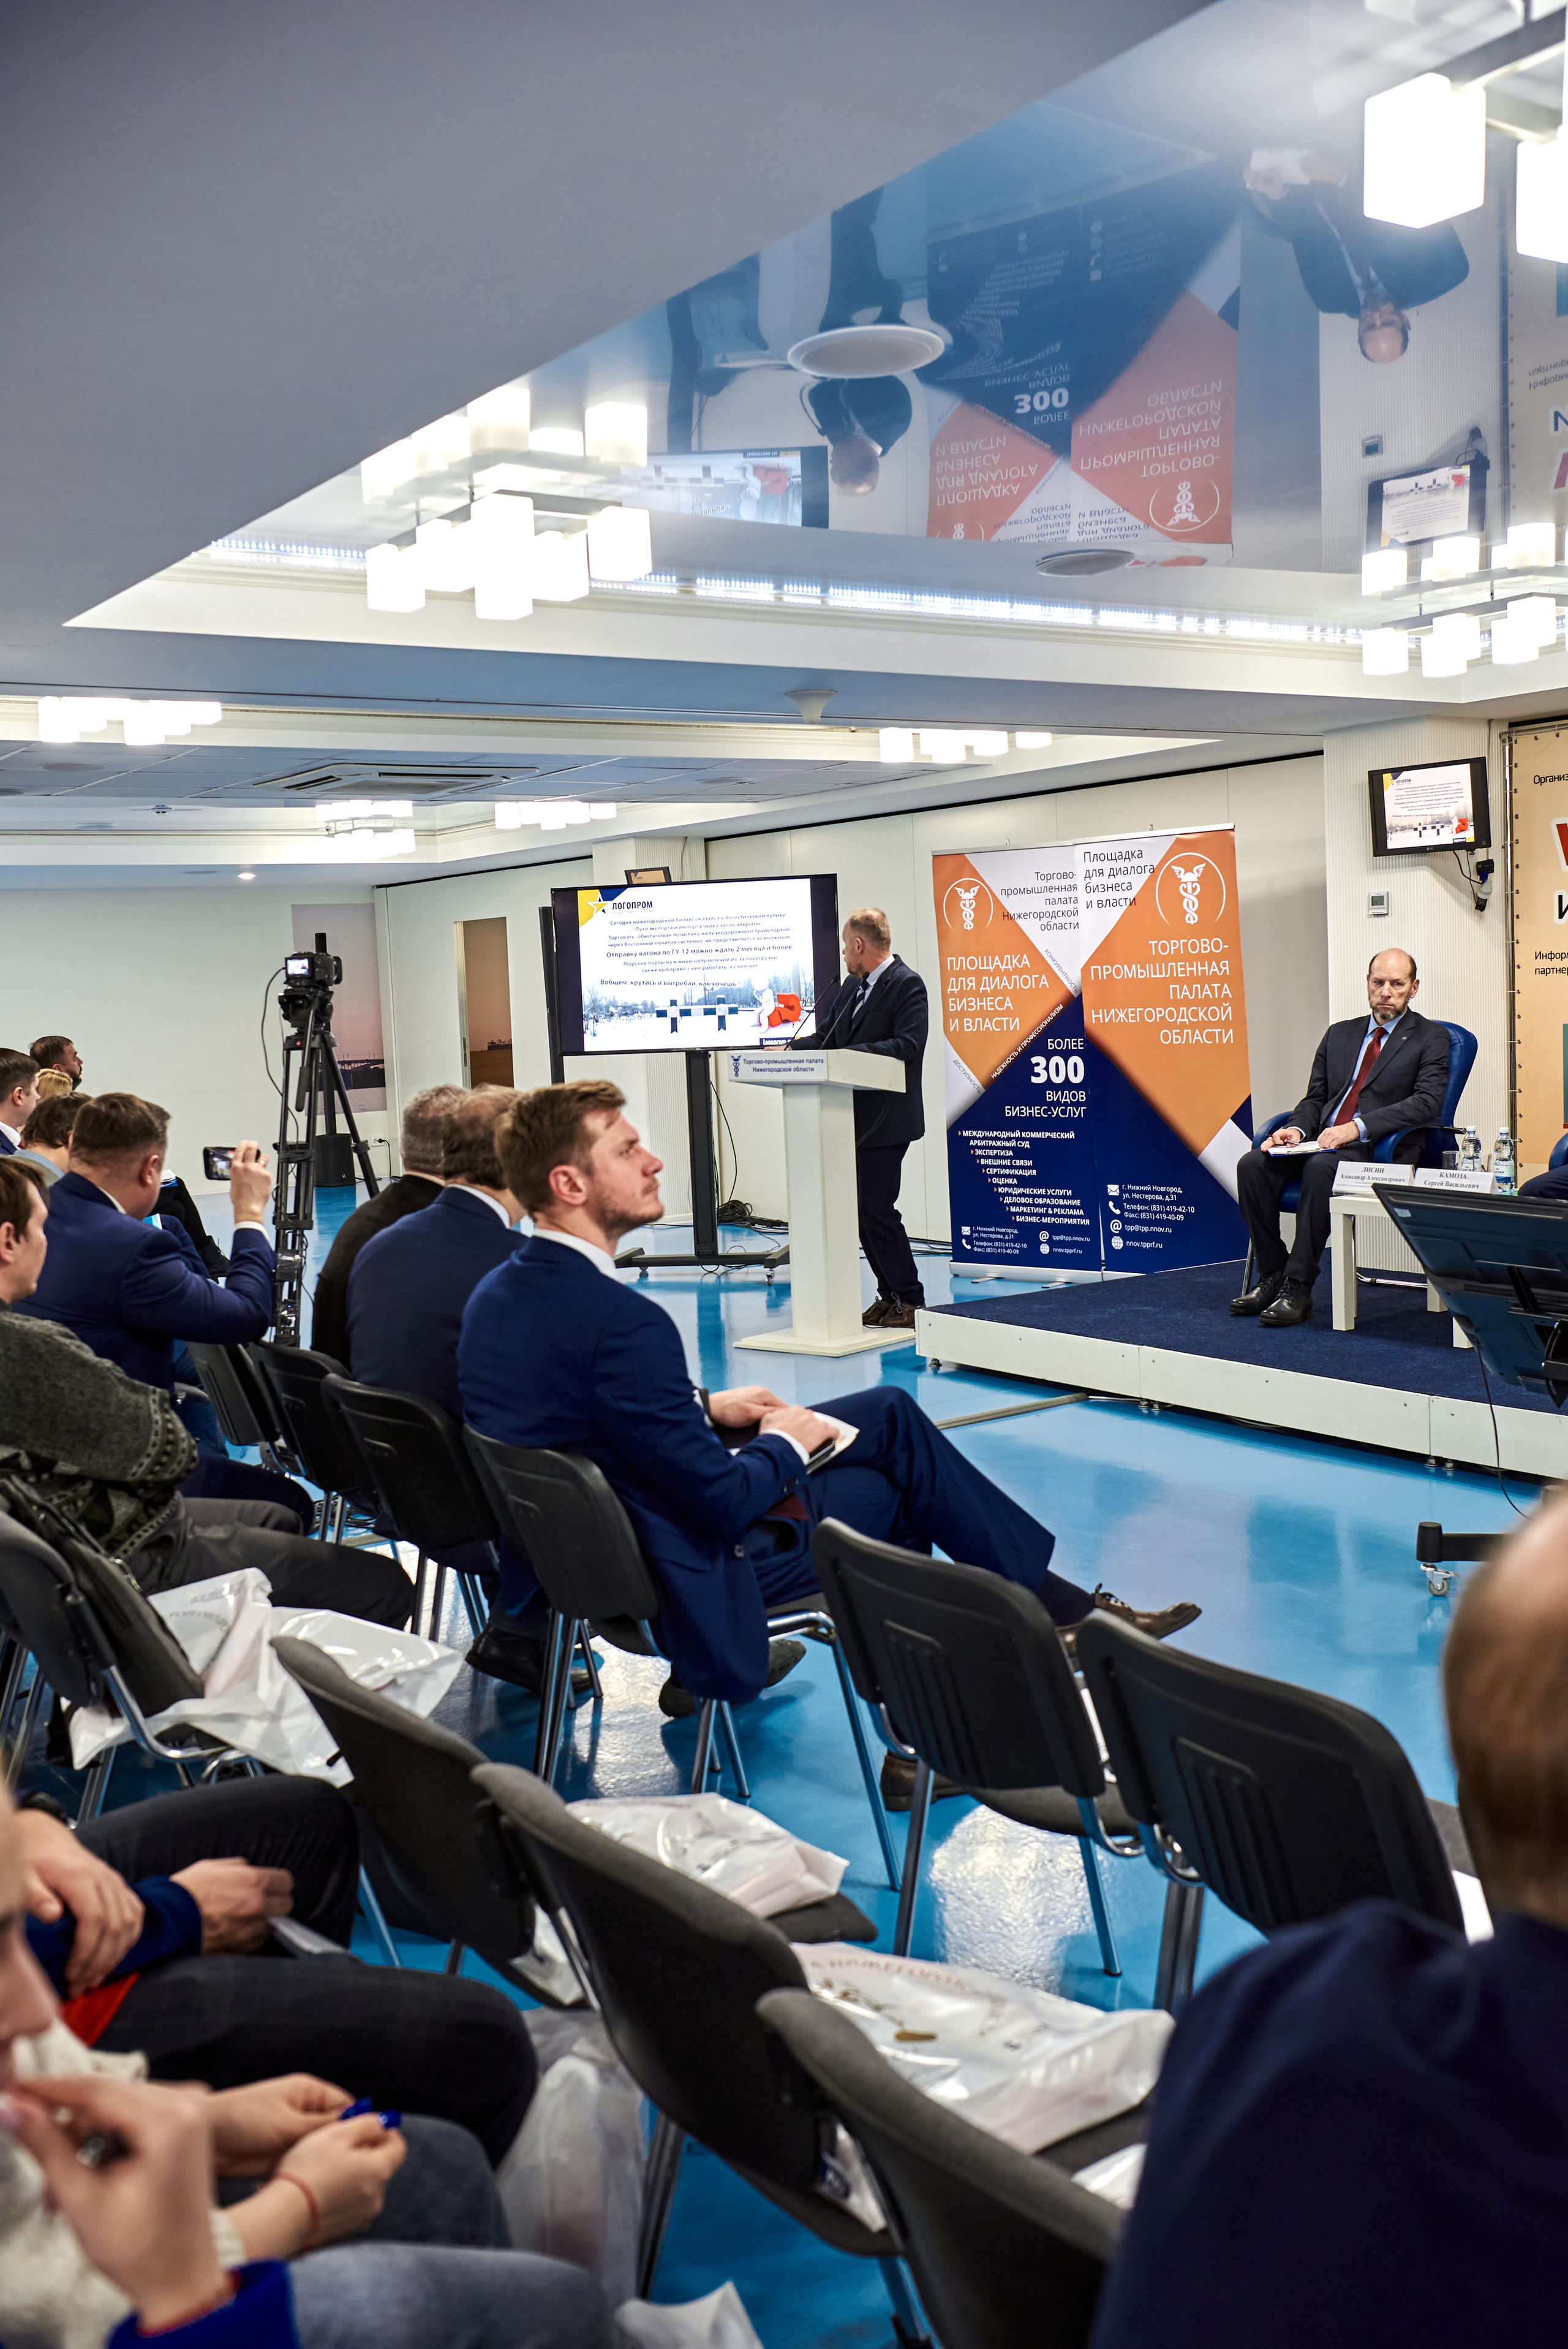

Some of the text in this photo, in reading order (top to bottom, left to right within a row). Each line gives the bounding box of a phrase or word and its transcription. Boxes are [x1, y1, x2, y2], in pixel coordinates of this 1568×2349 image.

[1084, 850, 1143, 863] Площадка
[1084, 864, 1155, 880] для диалога
[1001, 884, 1077, 898] промышленная
[1085, 882, 1132, 893] бизнеса
[612, 901, 653, 910] ЛОГОПРОМ
[1045, 896, 1078, 906] палата
[1087, 898, 1136, 909] и власти
[1003, 907, 1079, 921] Нижегородской
[1041, 921, 1079, 931] области
[1148, 938, 1229, 955] ТОРГОВО-
[948, 954, 1030, 972] ПЛОЩАДКА
[1535, 951, 1568, 961] Инфор
[1045, 948, 1078, 993] КОНКУРЕНТНОСТЬ
[1091, 961, 1229, 980] ПРОМЫШЛЕННАЯ
[1535, 967, 1568, 977] партне
[948, 975, 1049, 994] ДЛЯ ДИАЛОГА
[1170, 983, 1232, 999] ПАЛАТА
[949, 997, 1013, 1011] БИЗНЕСА
[1091, 1002, 1232, 1024] НИЖЕГОРОДСКОЙ
[950, 1017, 1019, 1031] И ВЛАСТИ
[991, 1051, 1019, 1079] НАДЕЖНОСТЬ
[1021, 1004, 1063, 1049] ПРОФЕССИОНАЛИЗМ
[1160, 1029, 1233, 1044] ОБЛАСТИ
[1048, 1038, 1084, 1050] БОЛЕЕ
[953, 1059, 981, 1093] ДОСТУПНОСТЬ
[1031, 1056, 1084, 1084] 300
[1046, 1091, 1086, 1103] ВИДОВ
[1005, 1106, 1087, 1118] БИЗНЕС-УСЛУГ
[1153, 1185, 1182, 1193] Новгород,
[1016, 1216, 1090, 1225] БИЗНЕС-МЕРОПРИЯТИЯ
